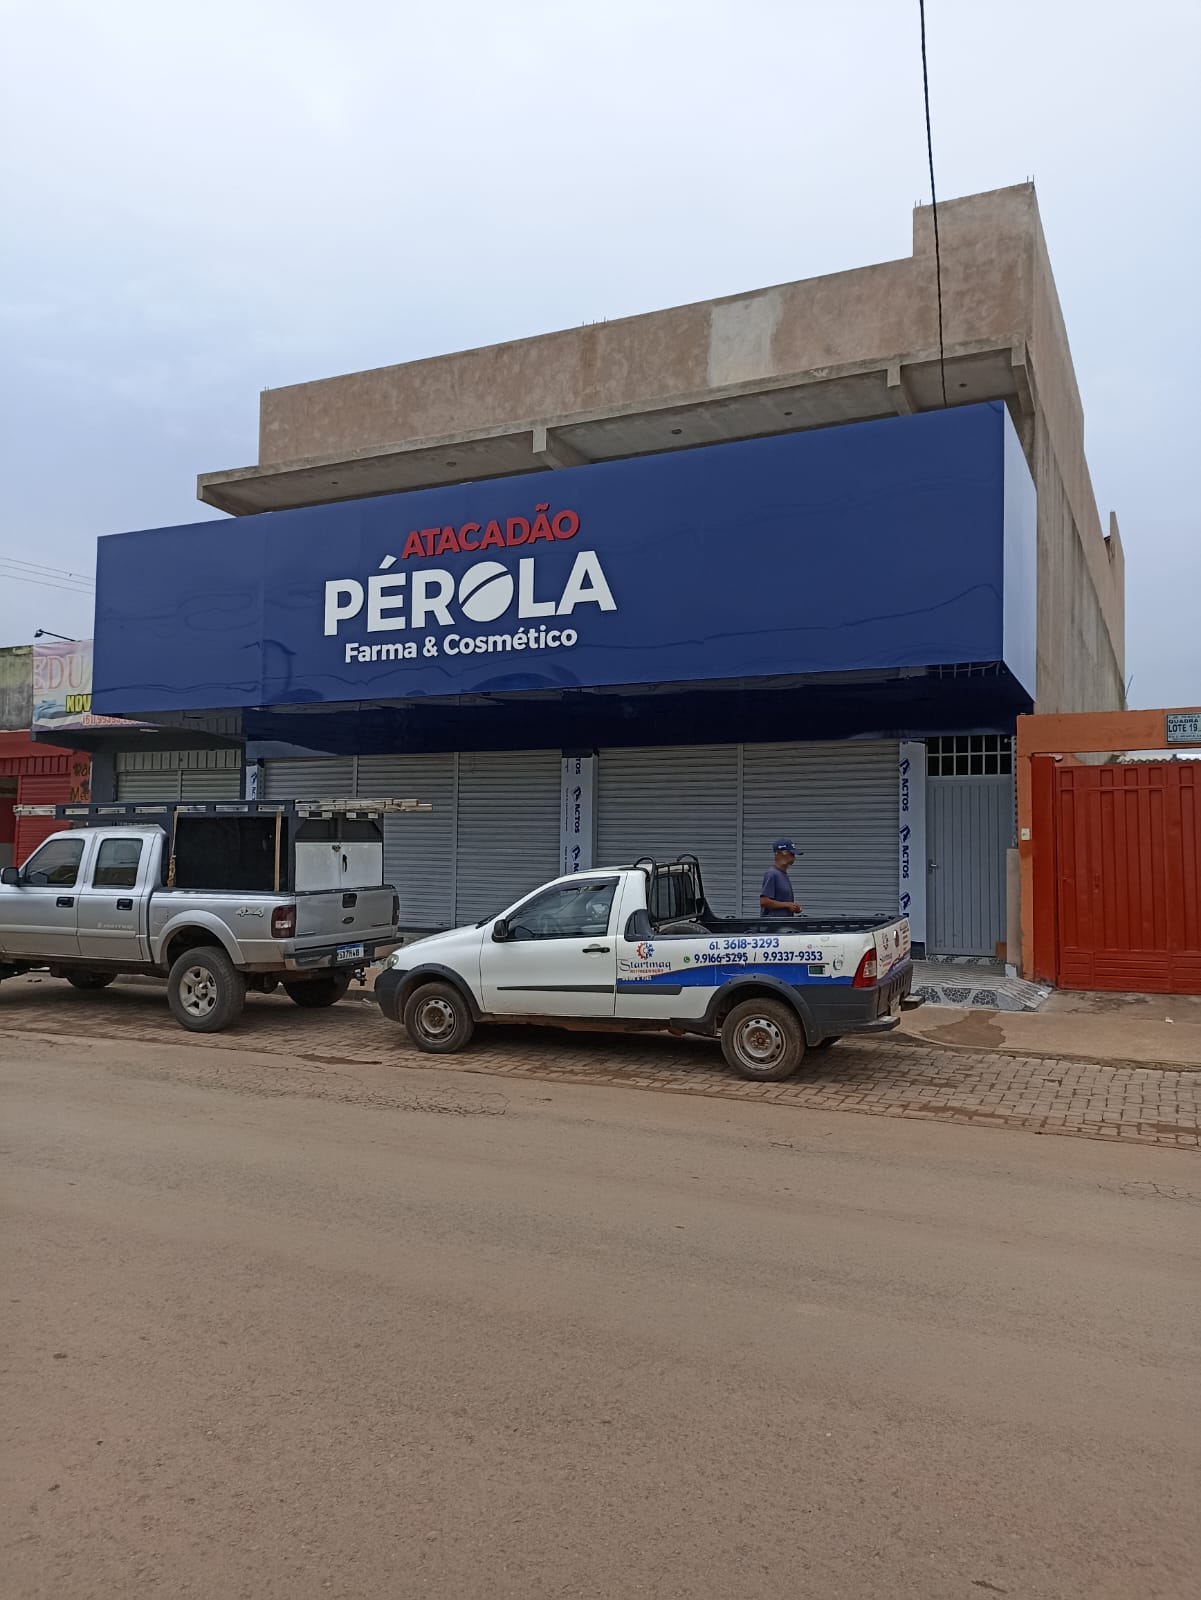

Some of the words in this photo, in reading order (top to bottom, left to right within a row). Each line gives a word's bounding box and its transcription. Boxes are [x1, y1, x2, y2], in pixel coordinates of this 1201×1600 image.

[402, 503, 580, 559] ATACADÃO
[324, 550, 617, 636] PÉROLA
[345, 641, 417, 663] Farma
[422, 636, 438, 656] &
[443, 625, 578, 655] Cosmético
[1168, 724, 1187, 733] LOTE
[723, 938, 780, 950] 3618-3293
[762, 951, 823, 961] 9.9337-9353
